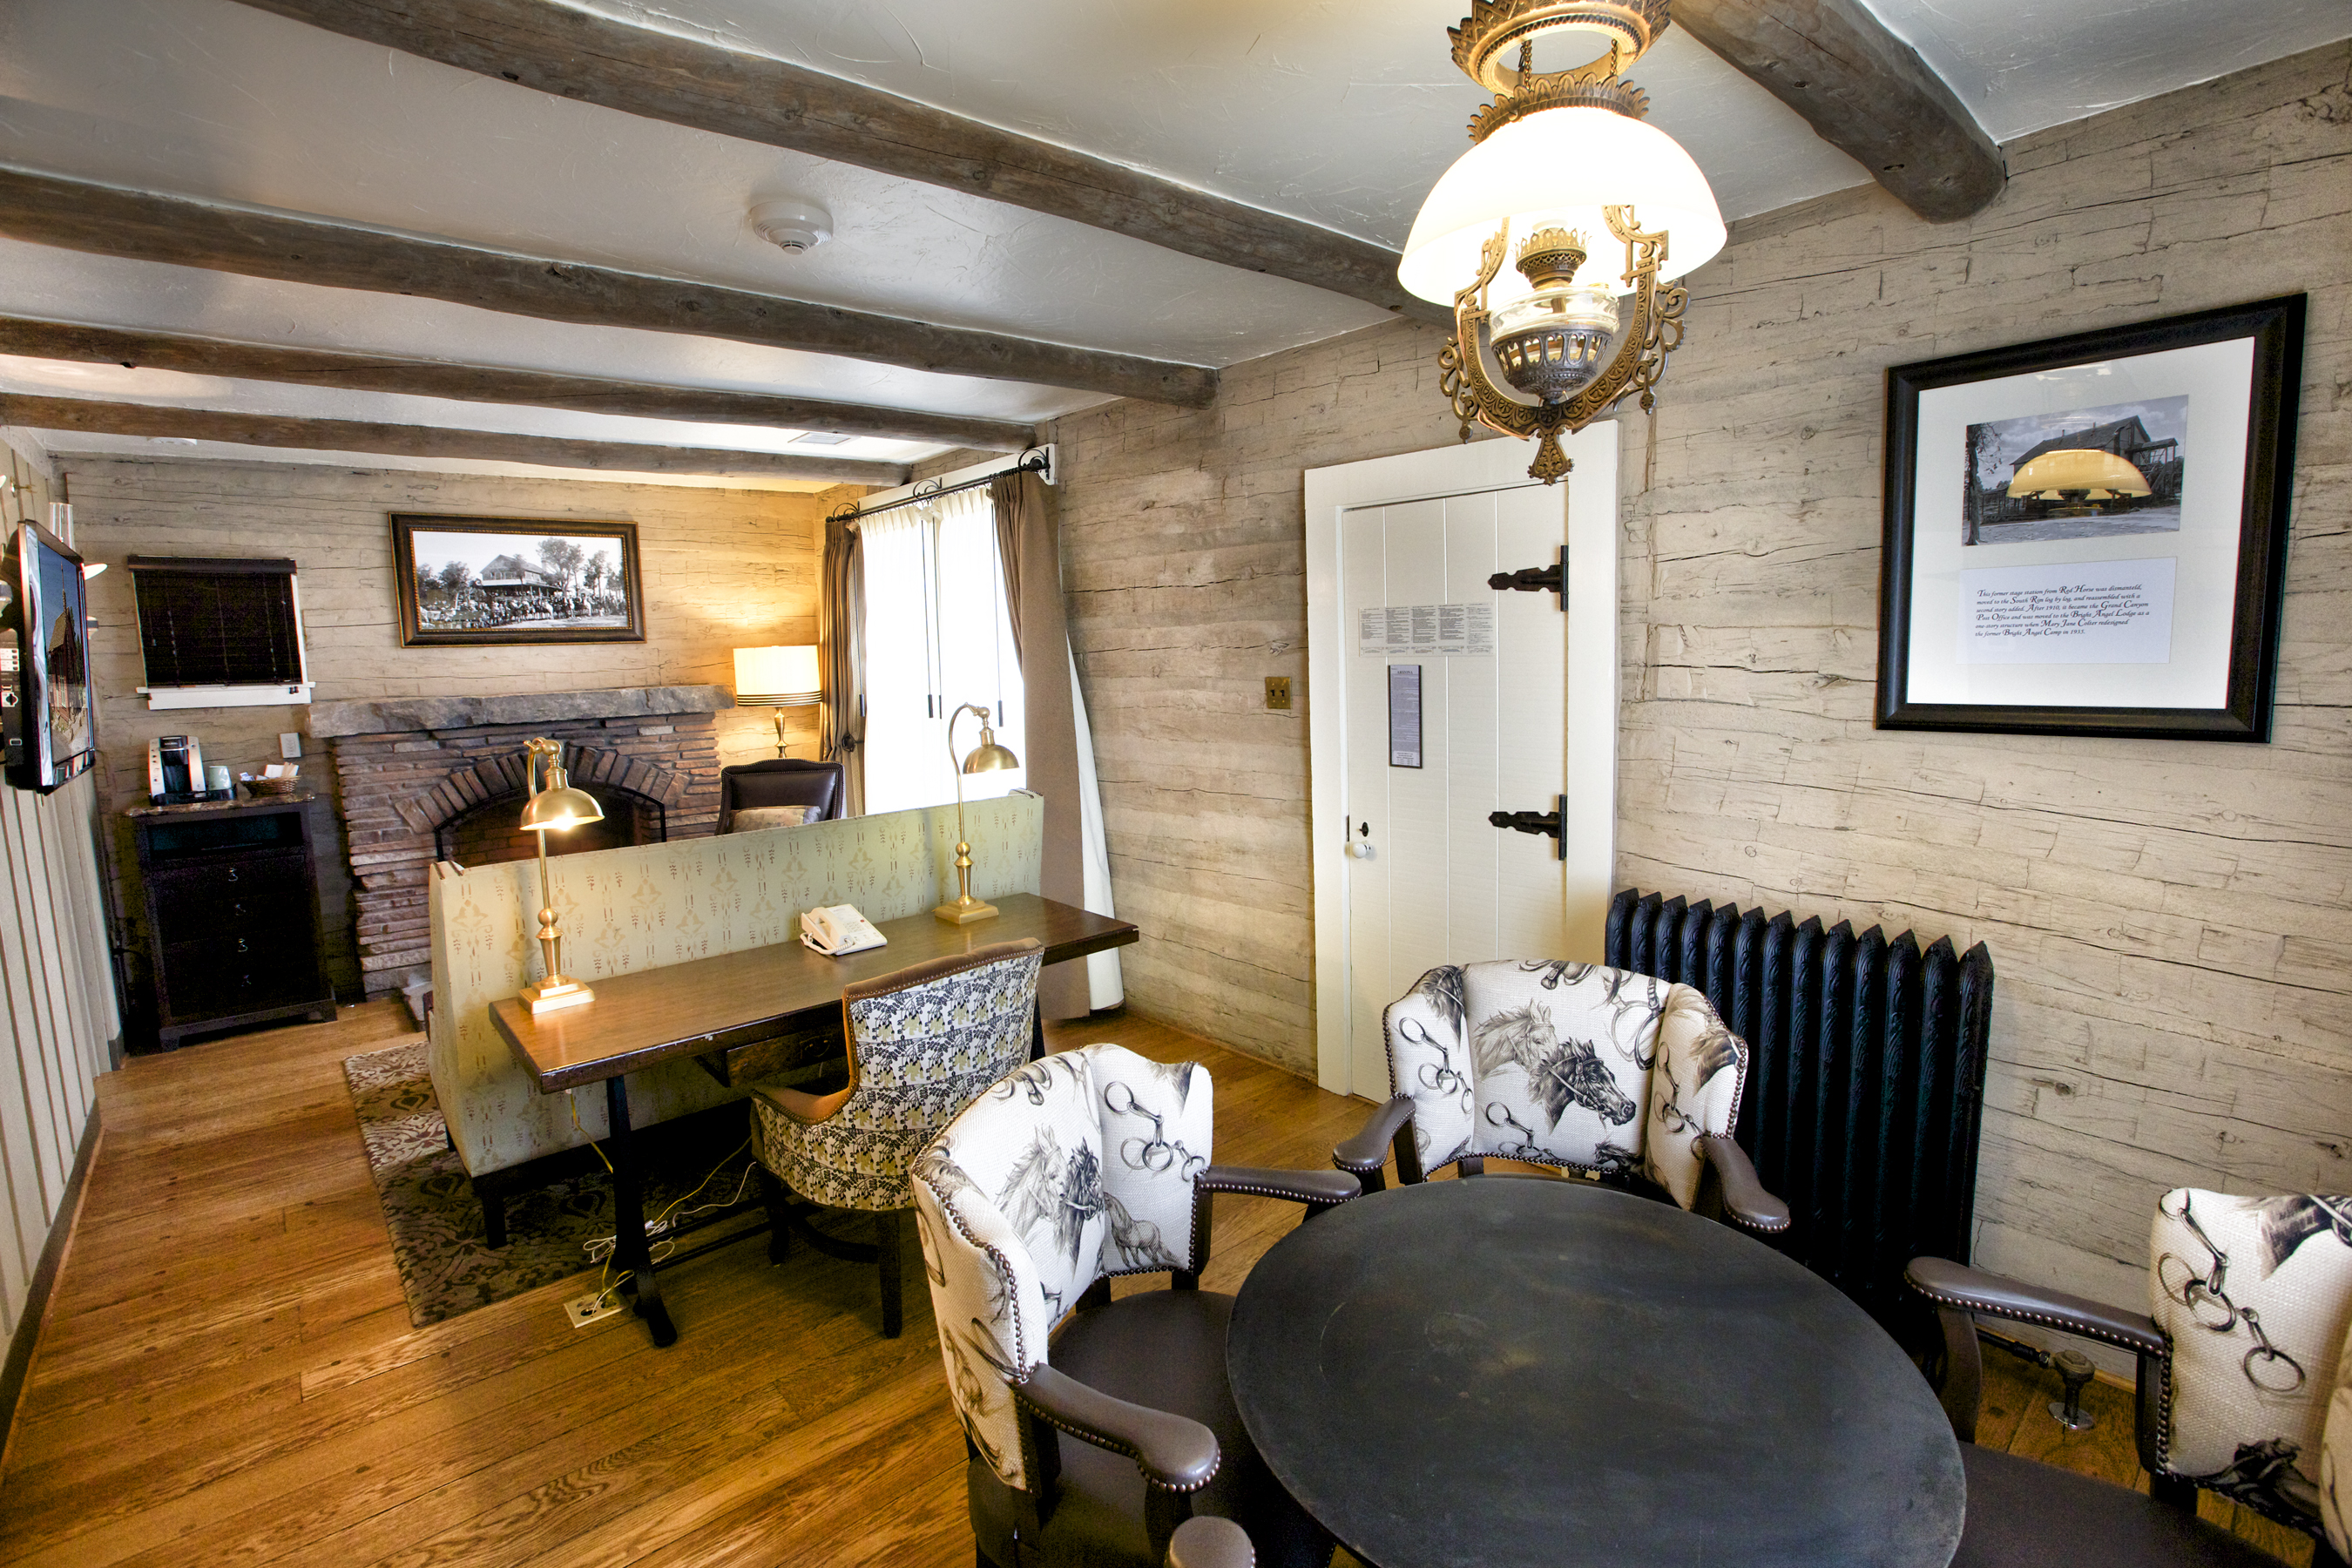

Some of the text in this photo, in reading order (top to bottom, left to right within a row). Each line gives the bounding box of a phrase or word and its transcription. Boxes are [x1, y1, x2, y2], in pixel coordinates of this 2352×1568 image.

[2058, 585, 2073, 594] Red
[2025, 604, 2044, 612] After
[2100, 601, 2123, 611] Grand
[2022, 628, 2043, 637] Angel
